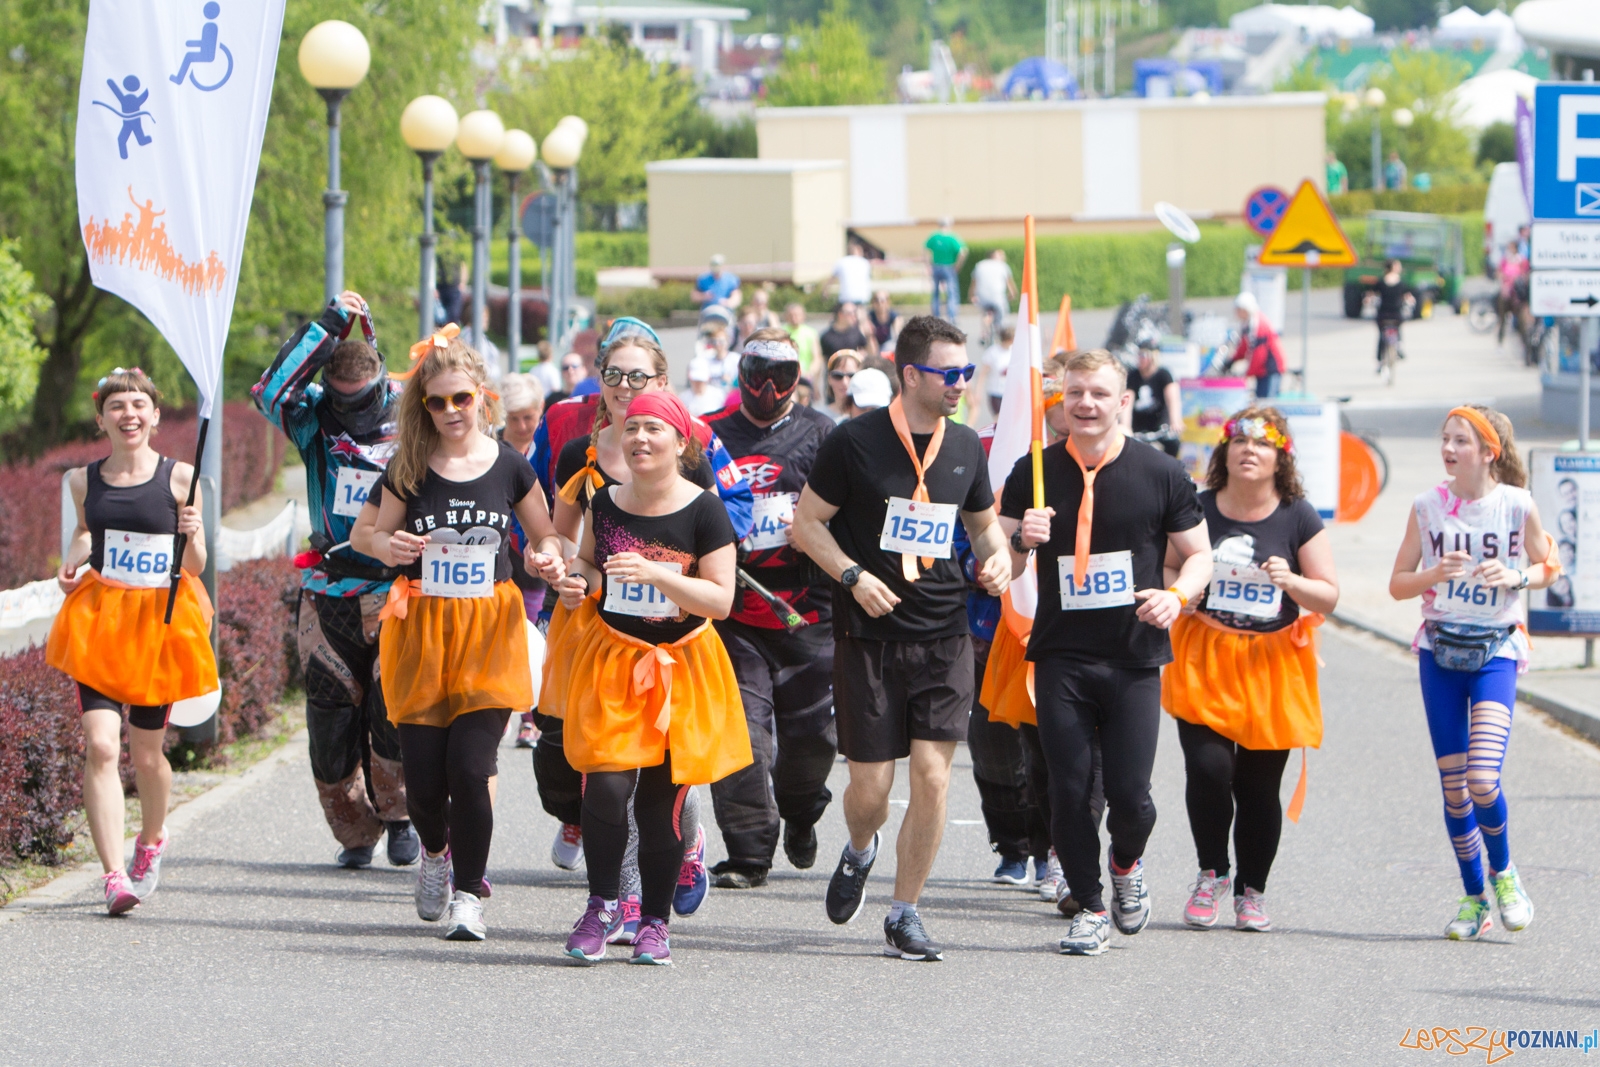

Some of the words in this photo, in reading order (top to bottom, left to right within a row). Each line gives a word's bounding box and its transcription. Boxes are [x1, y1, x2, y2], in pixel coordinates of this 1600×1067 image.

[414, 514, 436, 533] BE
[446, 509, 509, 529] HAPPY
[891, 515, 949, 545] 1520
[1428, 531, 1520, 559] MUSE
[108, 547, 168, 574] 1468
[430, 560, 486, 585] 1165
[1065, 569, 1127, 596] 1383
[1216, 579, 1276, 605] 1363
[1446, 580, 1499, 607] 1461
